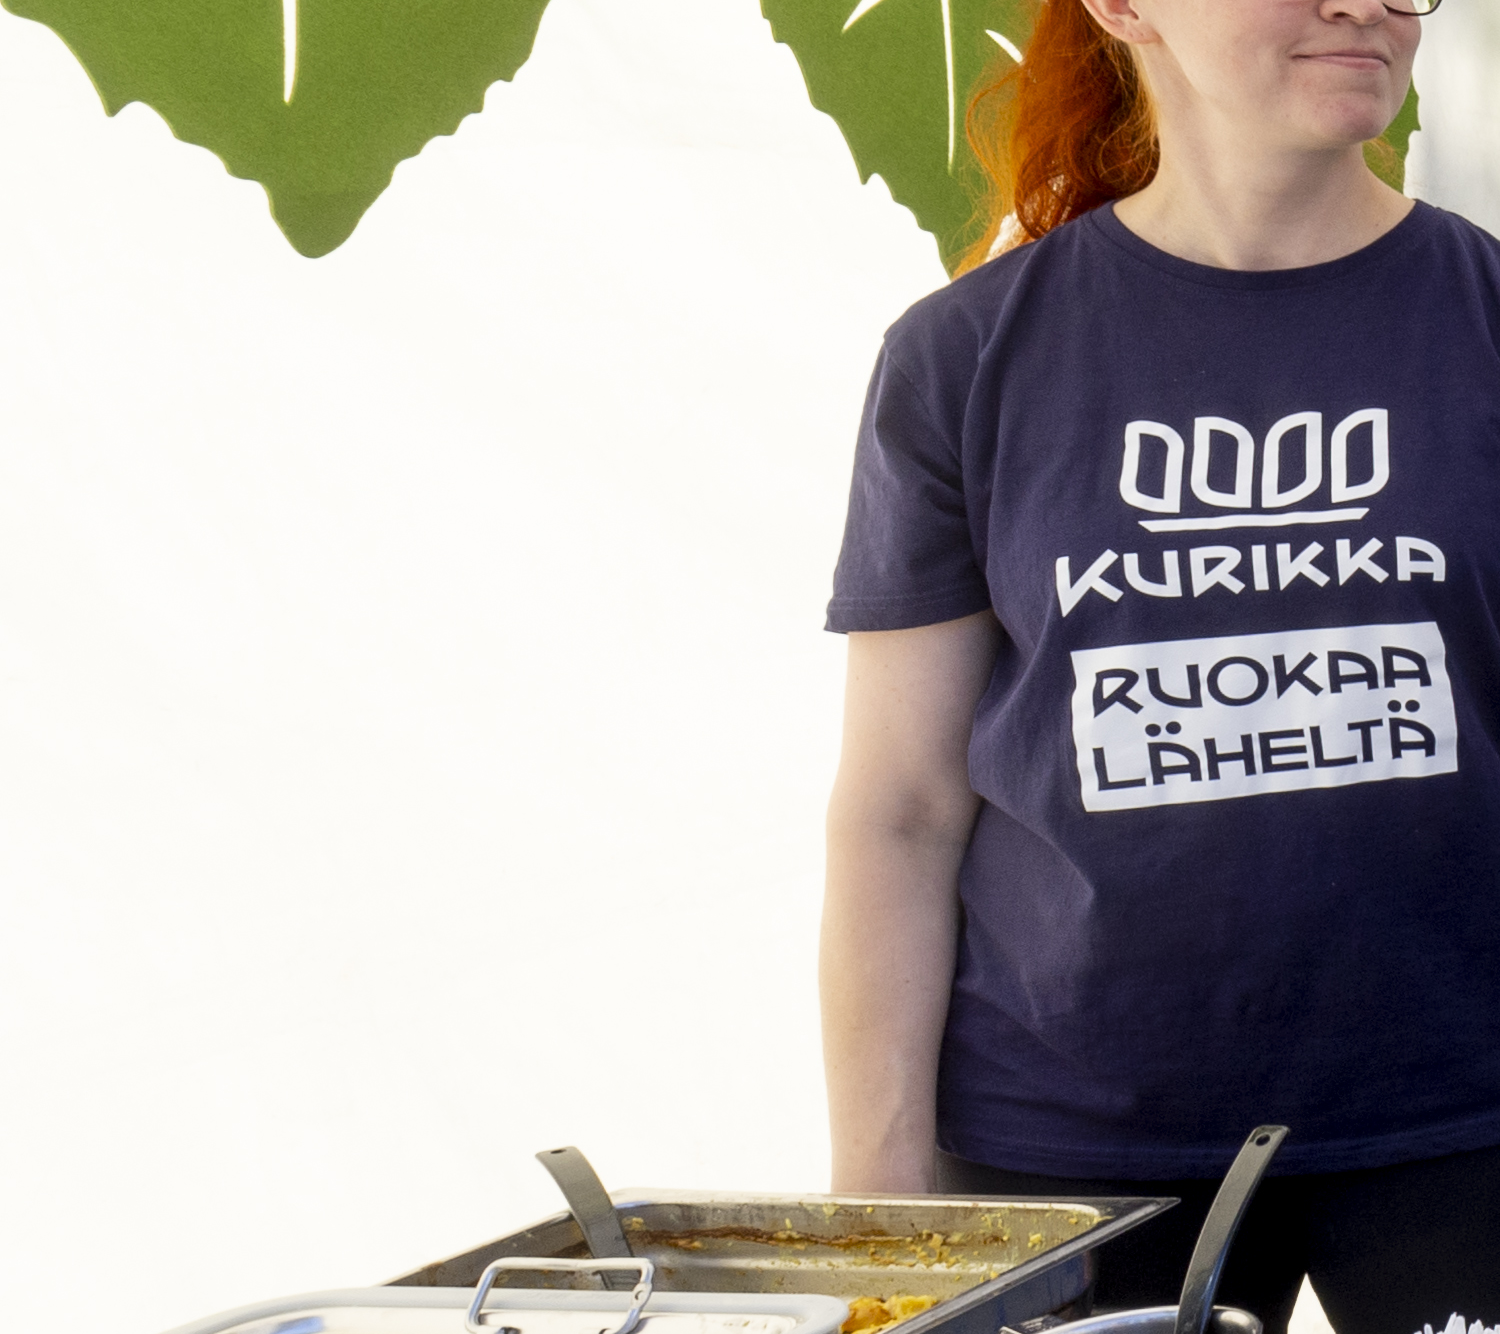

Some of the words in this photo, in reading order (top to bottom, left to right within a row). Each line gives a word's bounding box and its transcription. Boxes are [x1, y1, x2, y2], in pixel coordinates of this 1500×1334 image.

[1056, 536, 1446, 617] KURIKKA
[1093, 646, 1432, 718] RUOKAA
[1093, 699, 1436, 791] LÄHELTÄ
